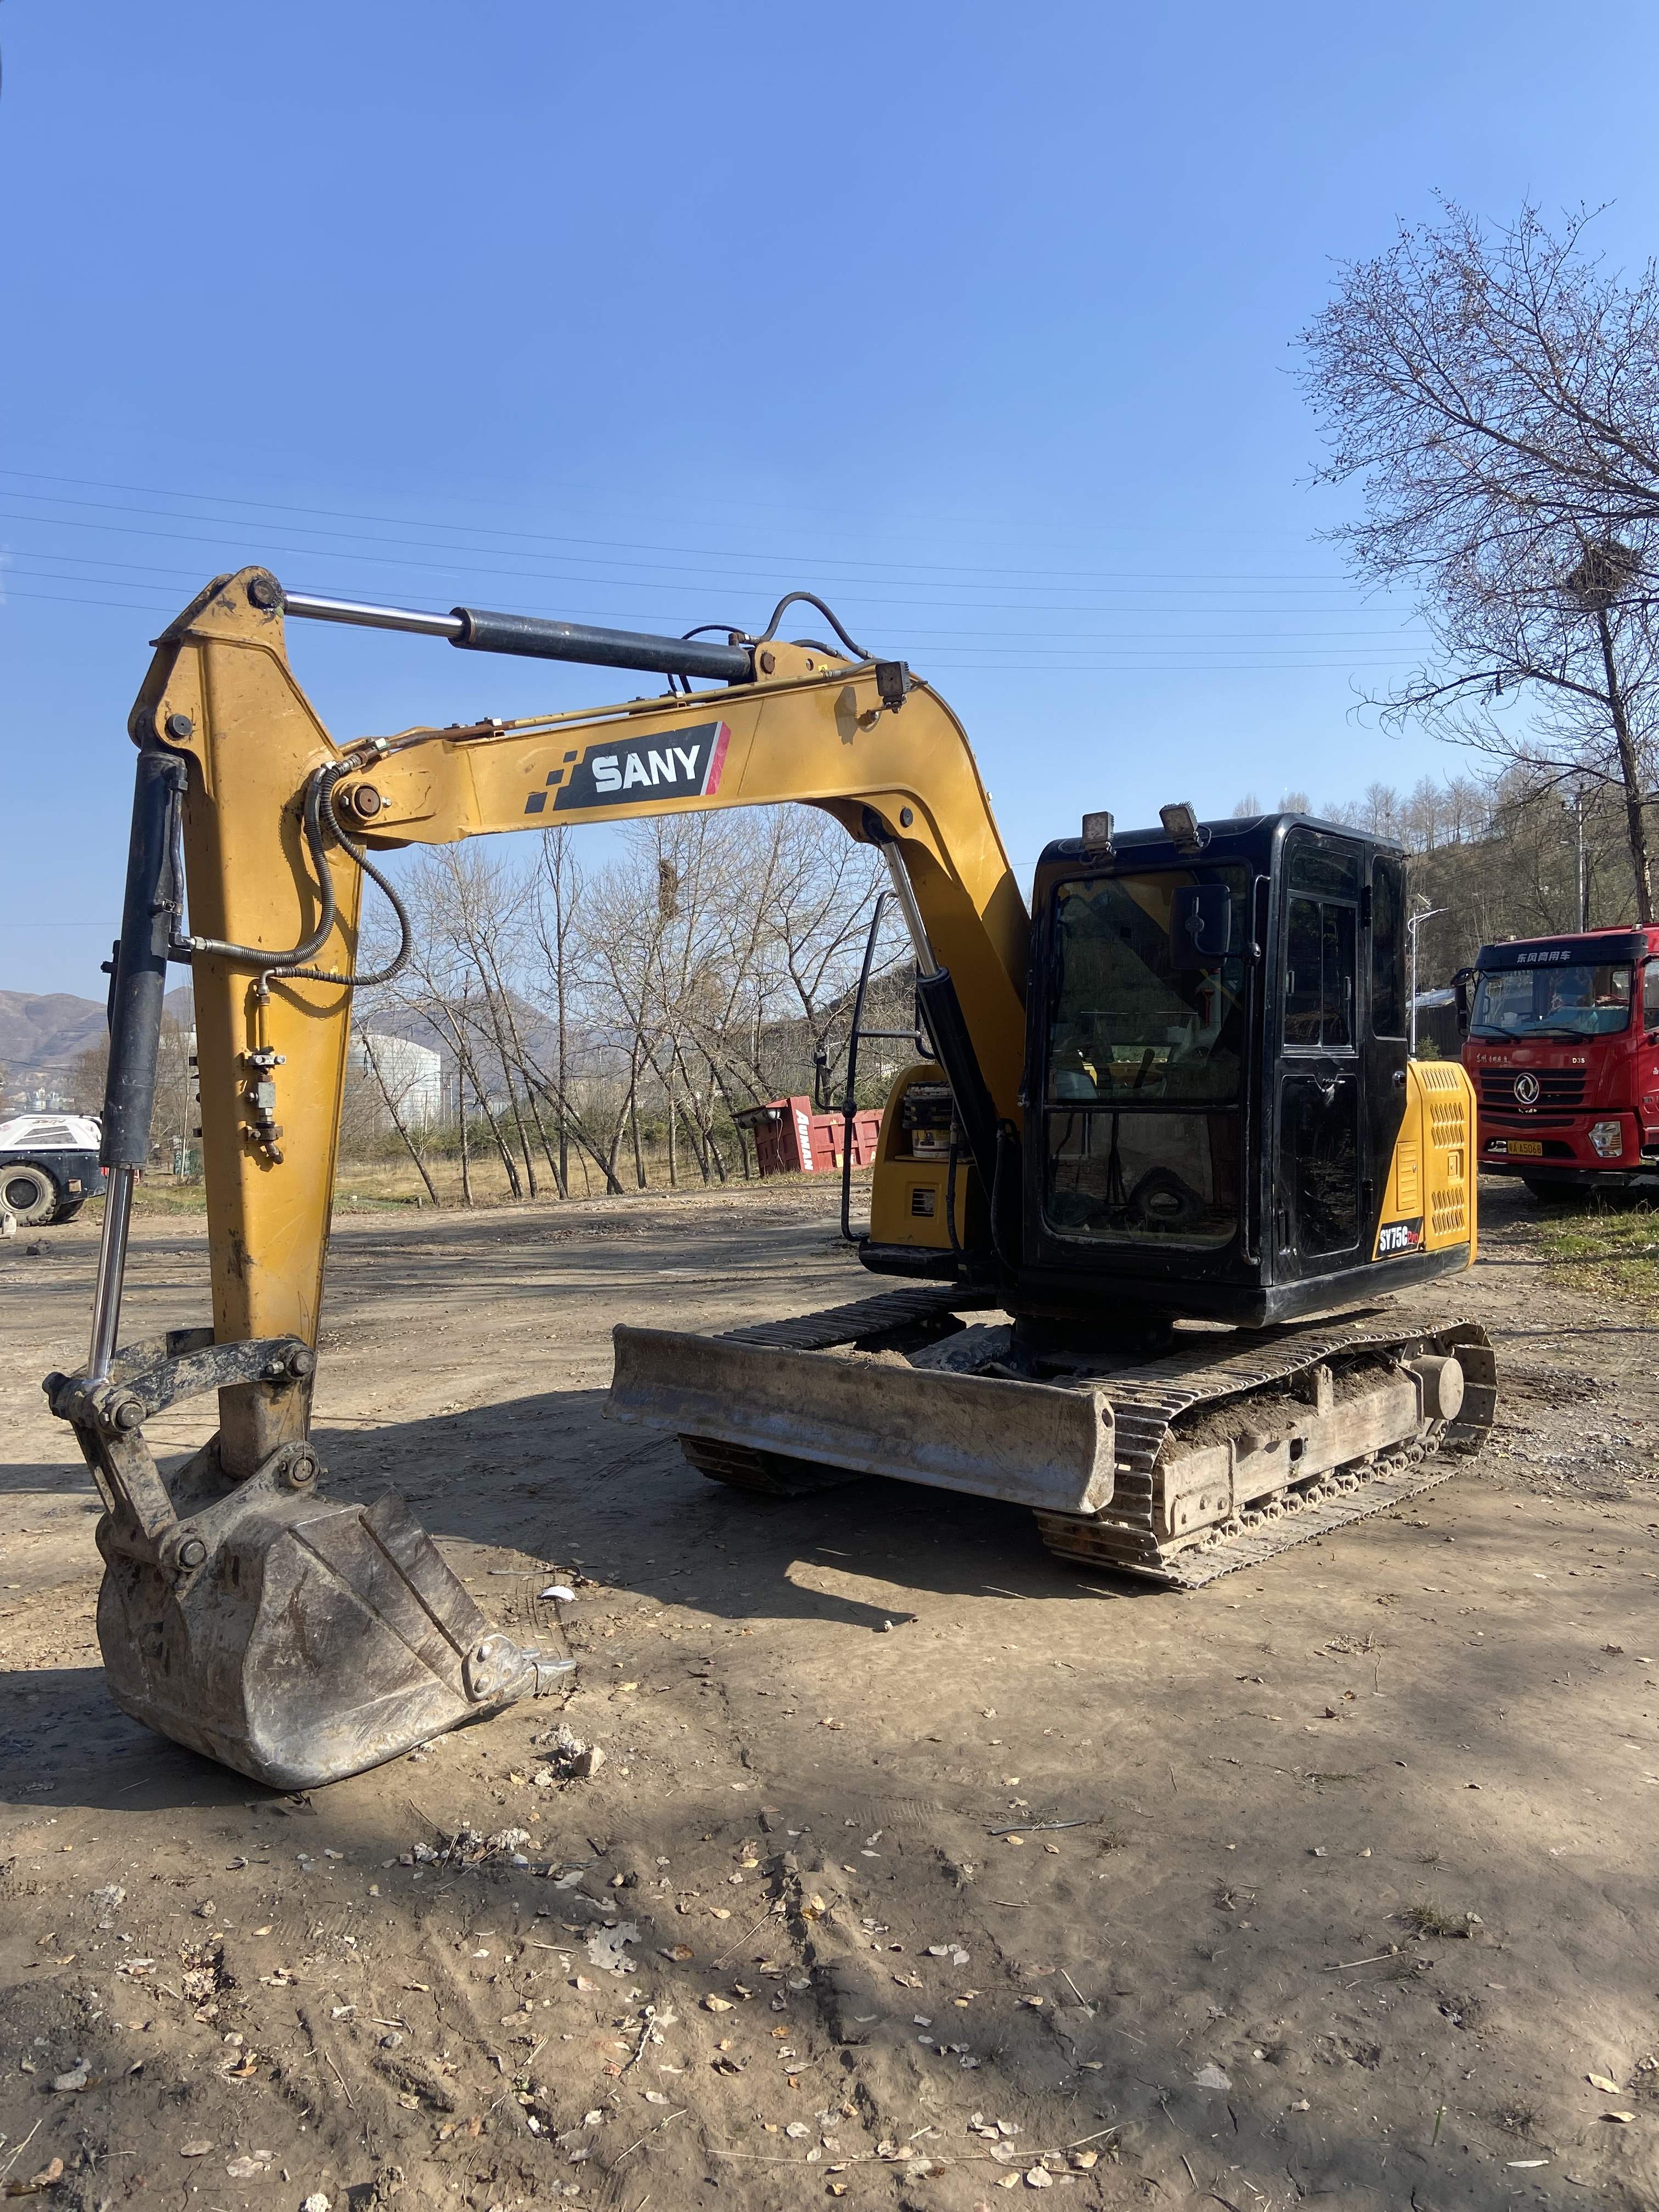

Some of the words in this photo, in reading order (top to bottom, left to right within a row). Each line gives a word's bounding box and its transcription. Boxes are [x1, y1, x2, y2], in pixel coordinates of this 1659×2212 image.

[591, 744, 701, 793] SANY
[1516, 951, 1571, 963] 东风商用车
[795, 1109, 814, 1170] AUMAN
